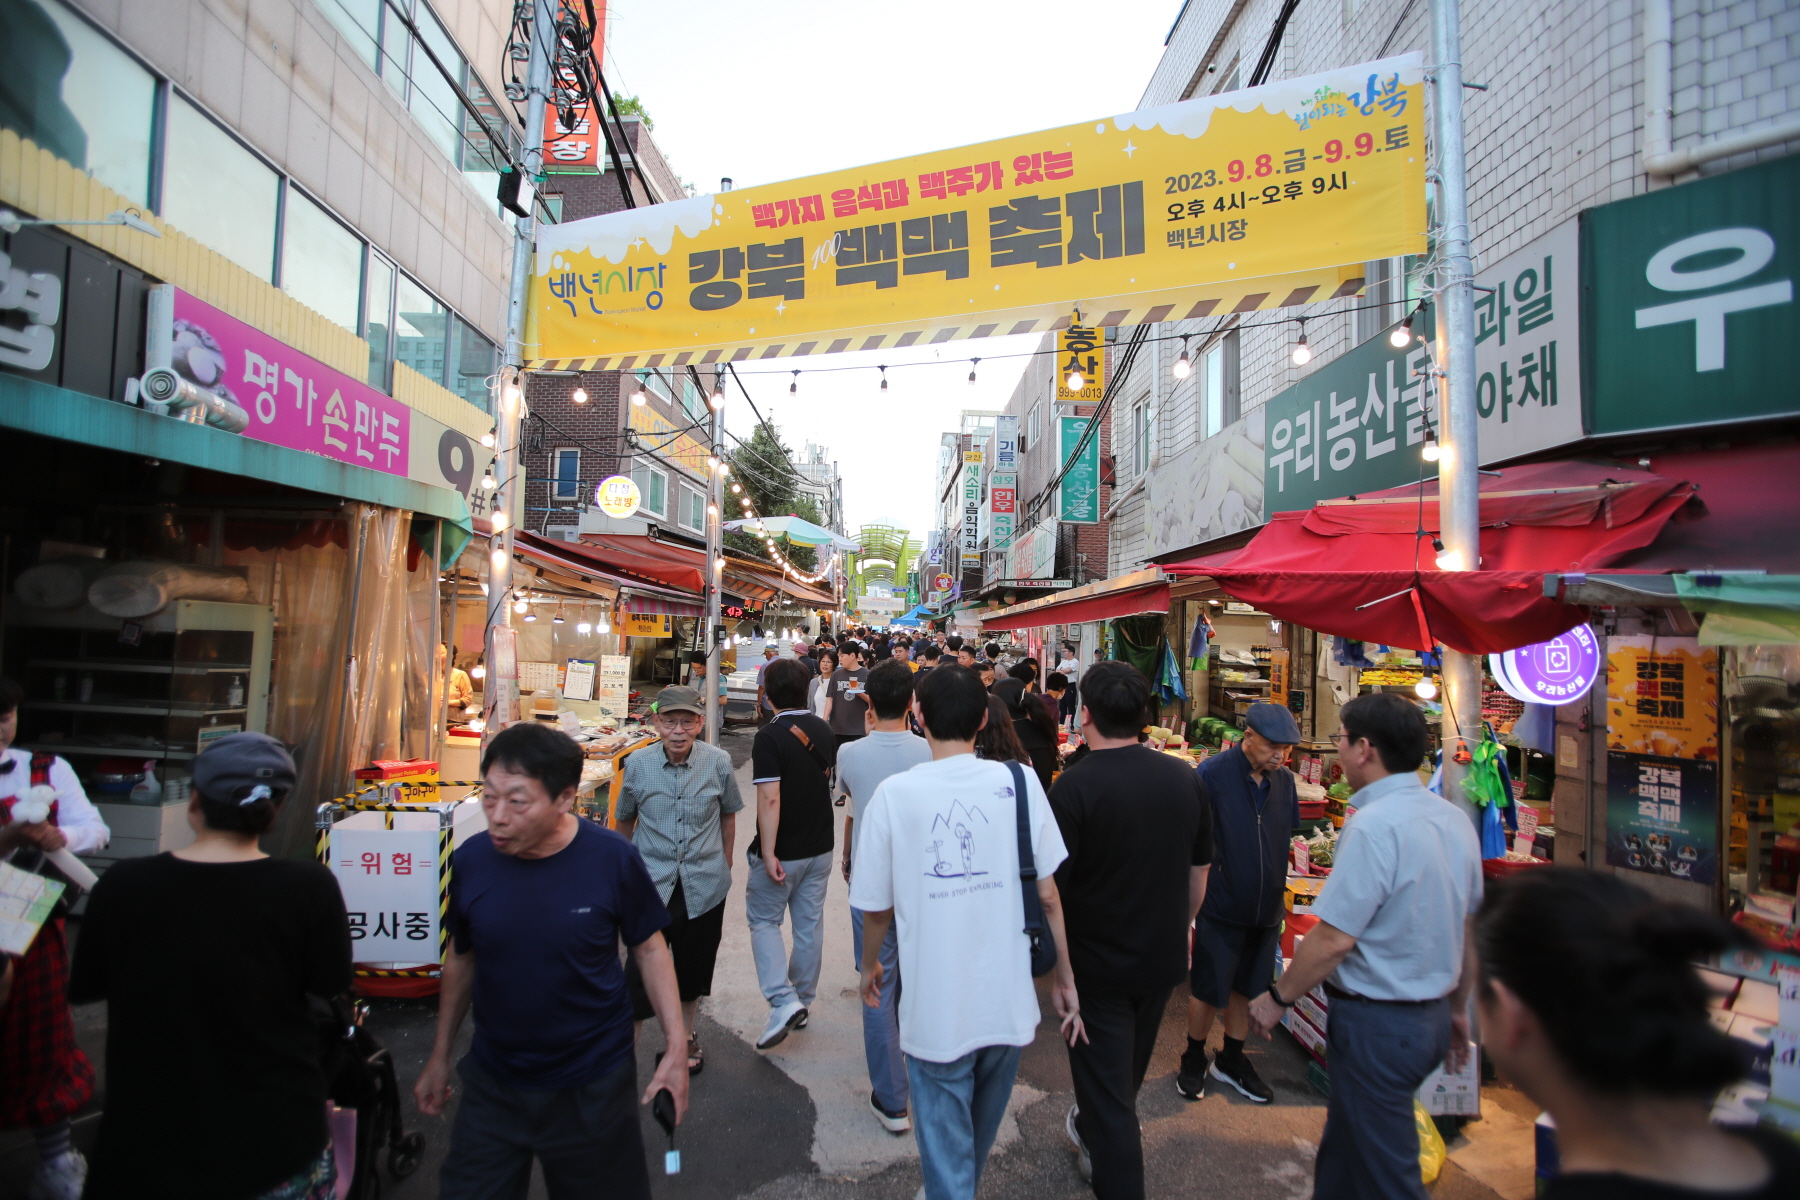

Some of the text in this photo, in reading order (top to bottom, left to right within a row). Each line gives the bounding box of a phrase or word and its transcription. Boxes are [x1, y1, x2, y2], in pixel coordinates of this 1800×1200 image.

[1347, 72, 1408, 117] 강북
[751, 151, 1074, 229] 백가지 음식과 맥주가 있는
[1167, 199, 1206, 223] 오후
[1312, 171, 1348, 195] 9시
[689, 180, 1145, 311] 강북 100 백맥 축제
[1167, 218, 1248, 249] 백년시장
[549, 262, 667, 318] 백년시장
[1475, 255, 1555, 347] 과일
[1634, 227, 1793, 373] 우
[1063, 309, 1098, 384] 동산
[1476, 340, 1558, 423] 야채
[243, 348, 401, 469] 명가 손만두
[999, 440, 1015, 461] 기름
[965, 464, 979, 500] 새소리
[995, 490, 1013, 511] 한우
[964, 501, 979, 552] 음악학원
[388, 771, 403, 779] Sweet
[1638, 765, 1681, 787] 강북
[1638, 801, 1681, 822] 축제
[929, 881, 1004, 900] NEVER STOP EXPLORING
[347, 911, 430, 940] 공사중
